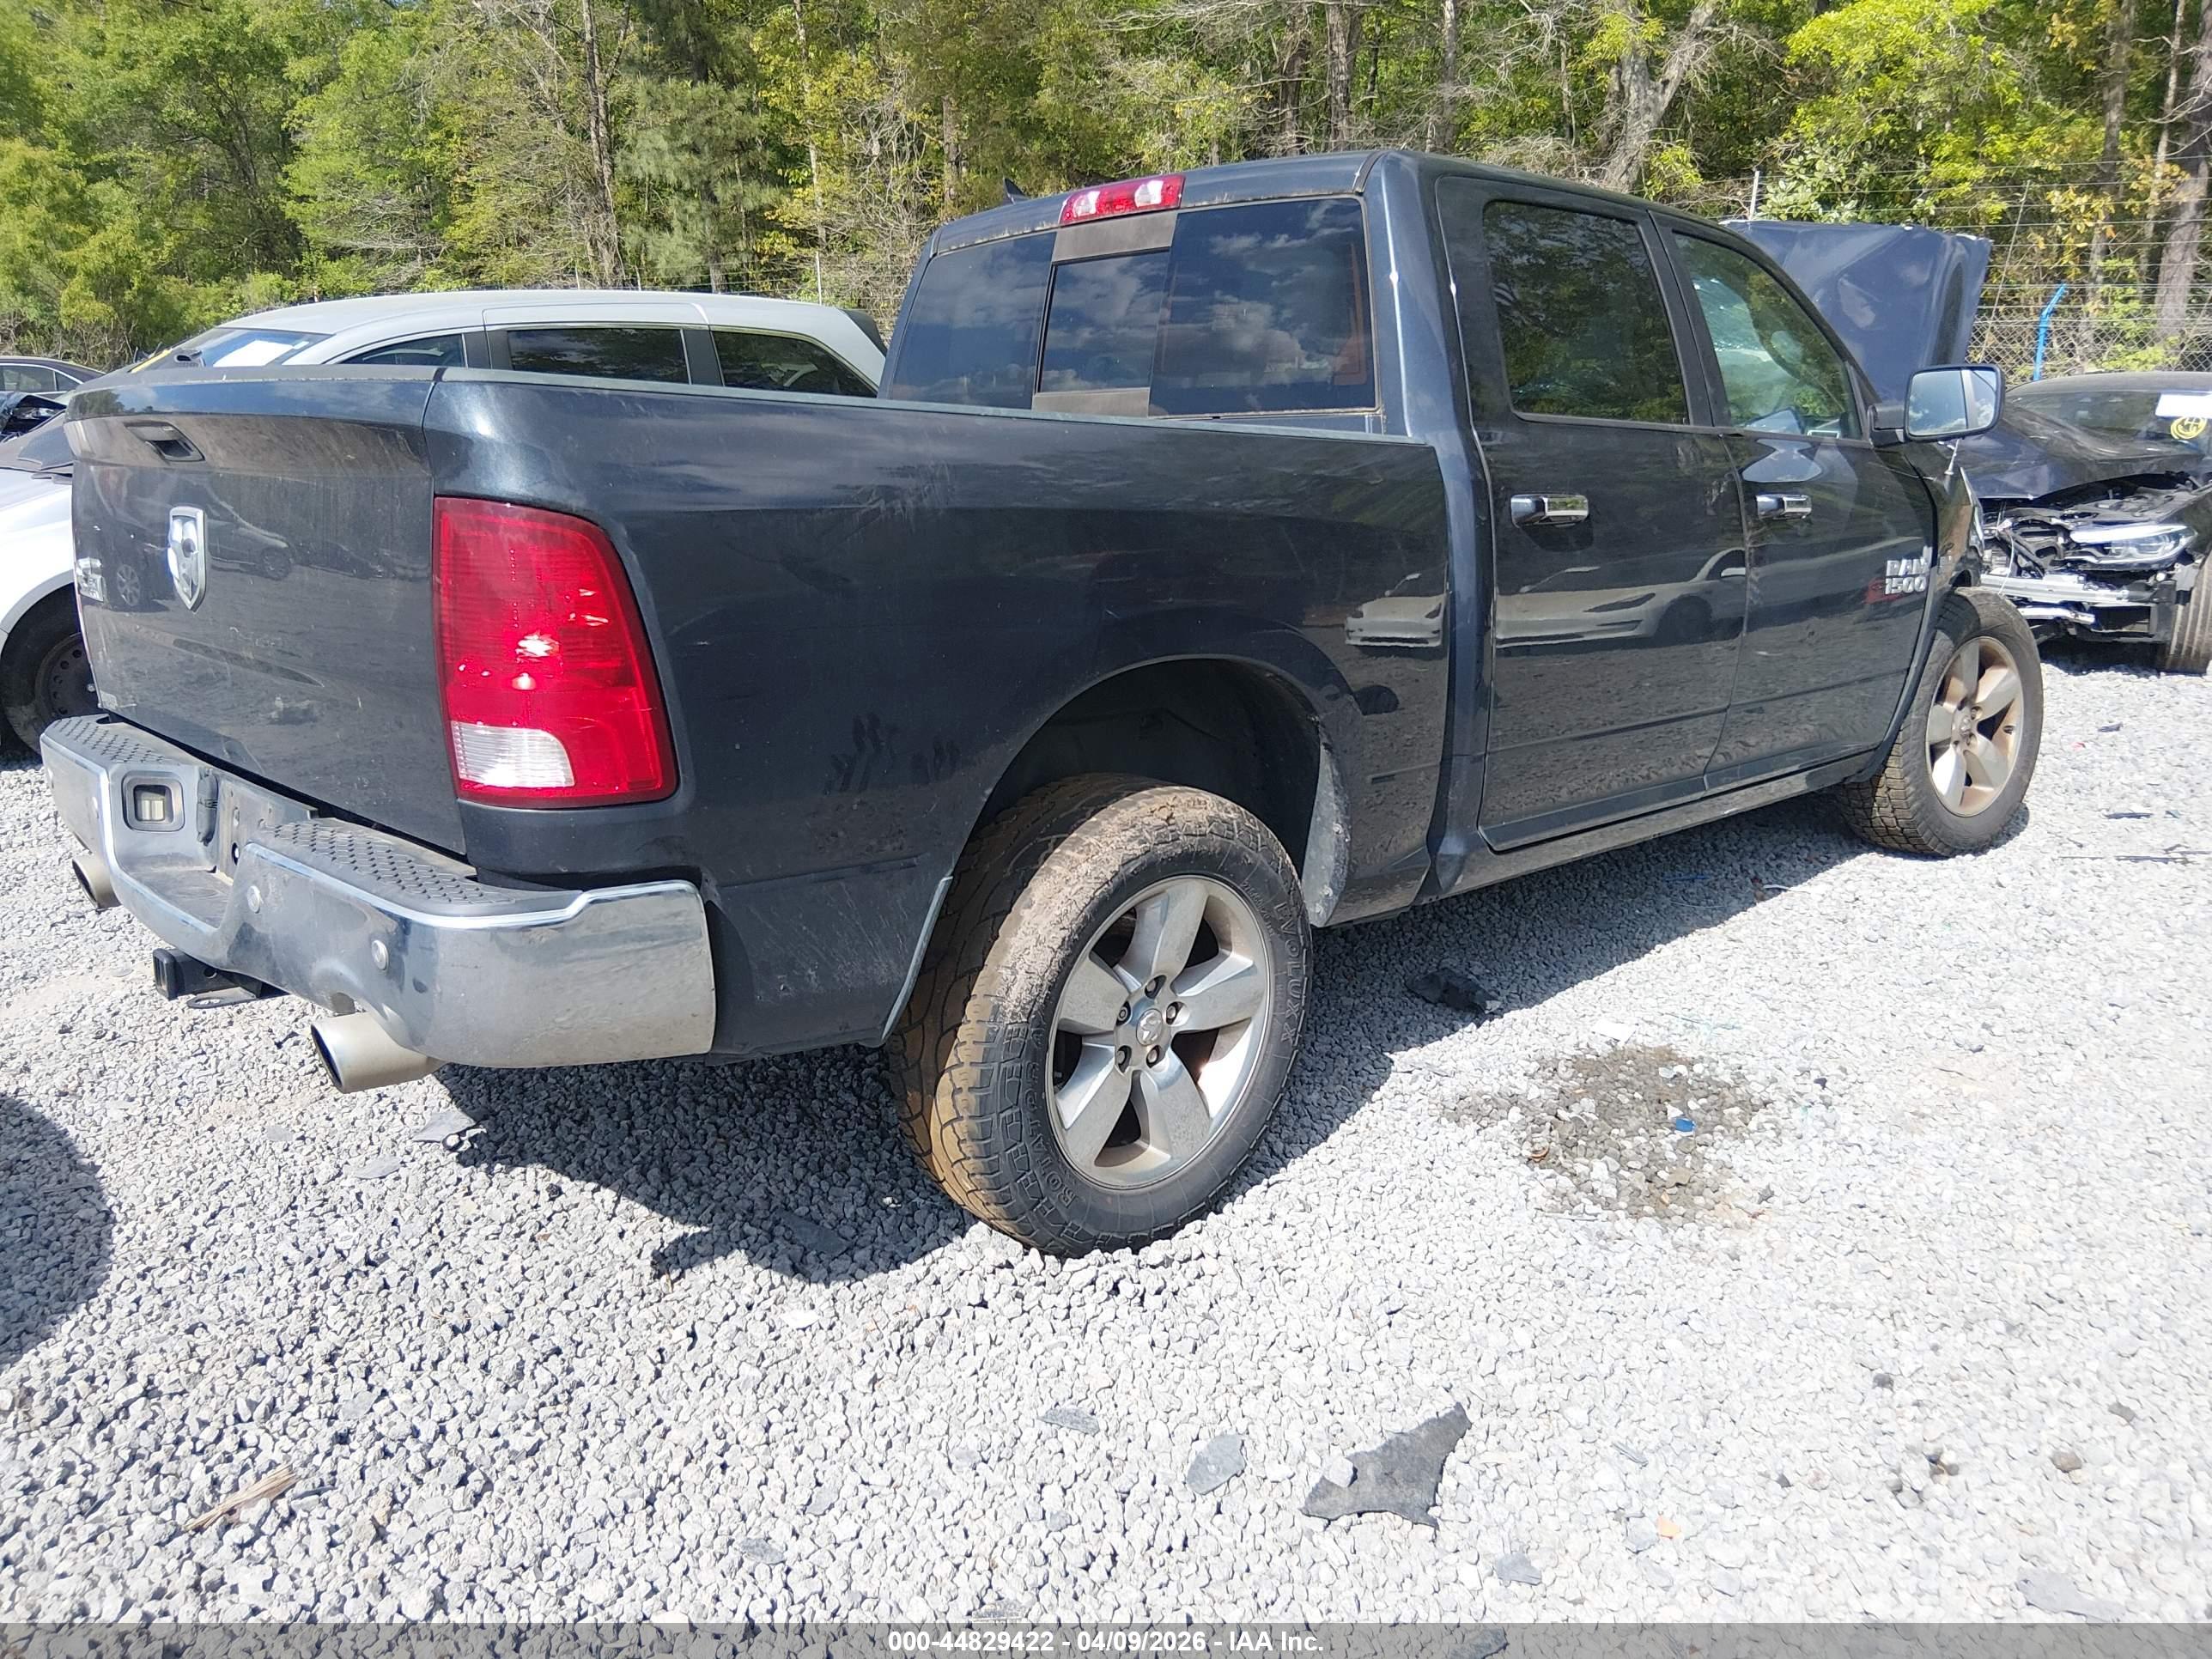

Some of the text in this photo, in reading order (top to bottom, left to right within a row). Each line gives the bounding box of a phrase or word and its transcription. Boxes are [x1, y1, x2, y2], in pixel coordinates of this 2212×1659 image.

[1885, 576, 1927, 594] 1500
[1886, 546, 1933, 576] RAM
[1274, 902, 1302, 1043] EVOLUXX
[1025, 1060, 1075, 1209] ROTATOR
